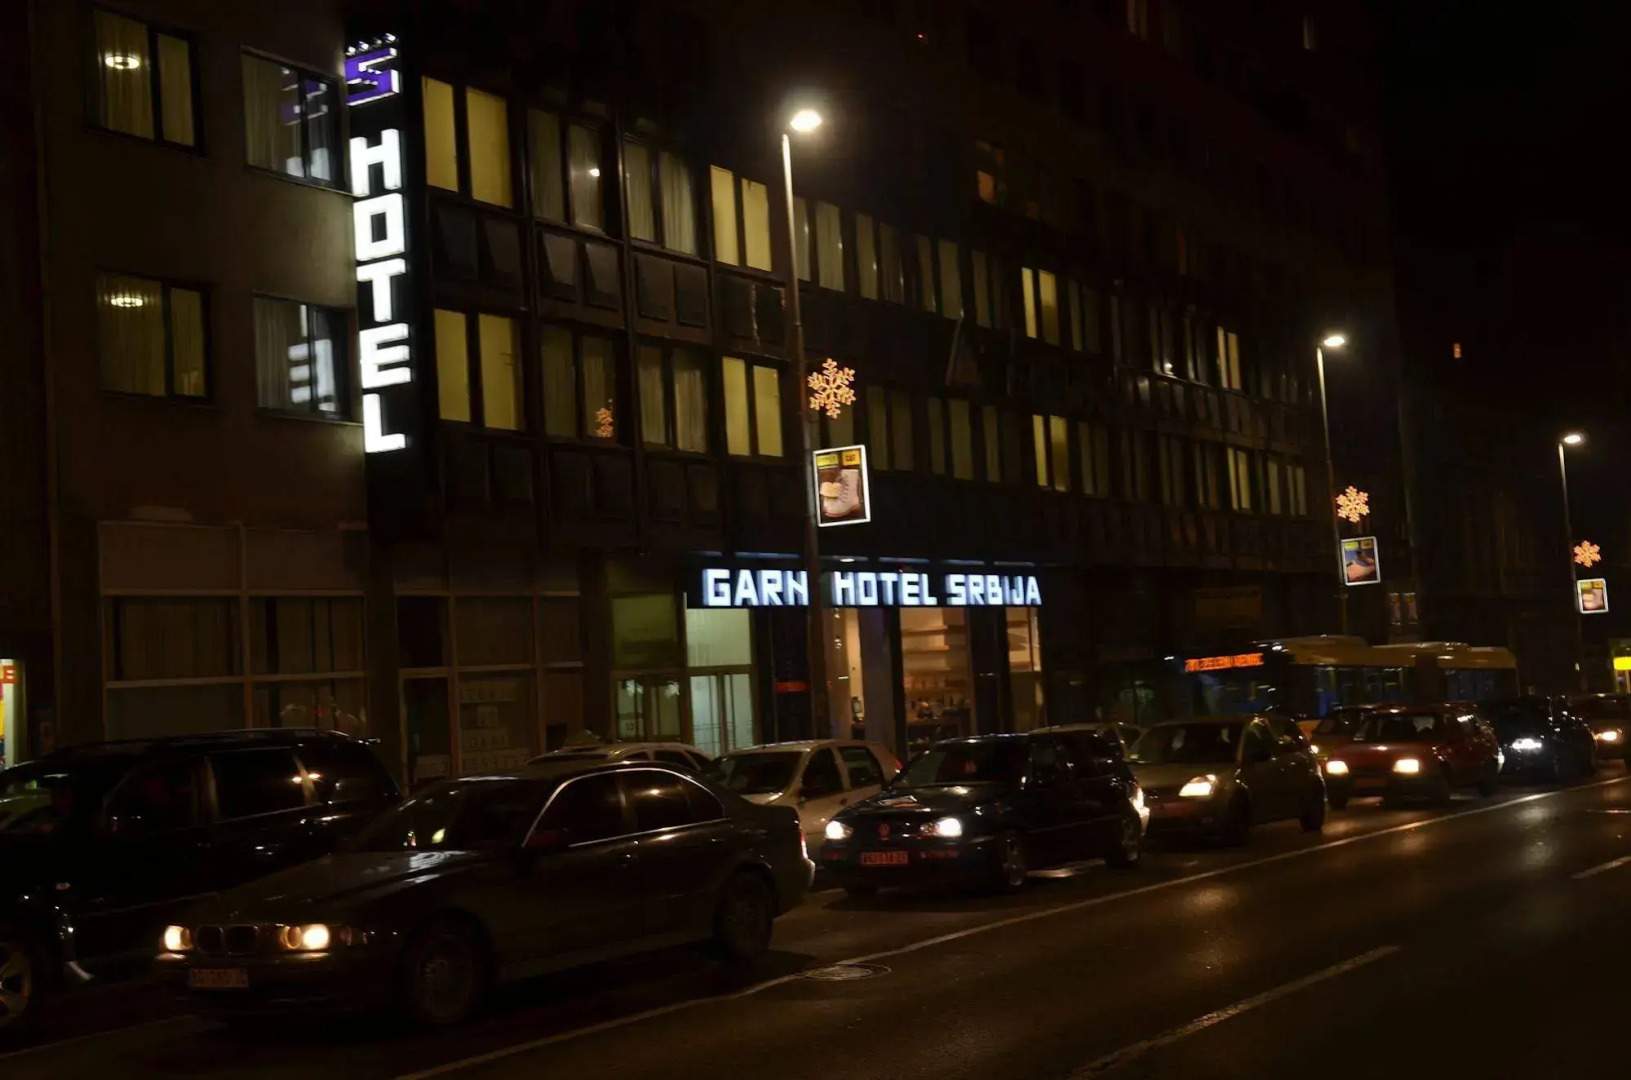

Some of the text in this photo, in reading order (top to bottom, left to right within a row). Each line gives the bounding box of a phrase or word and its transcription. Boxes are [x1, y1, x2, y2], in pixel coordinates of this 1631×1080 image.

[349, 128, 412, 455] HOTEL
[831, 570, 938, 607] HOTEL
[945, 574, 1042, 607] SRBIJA
